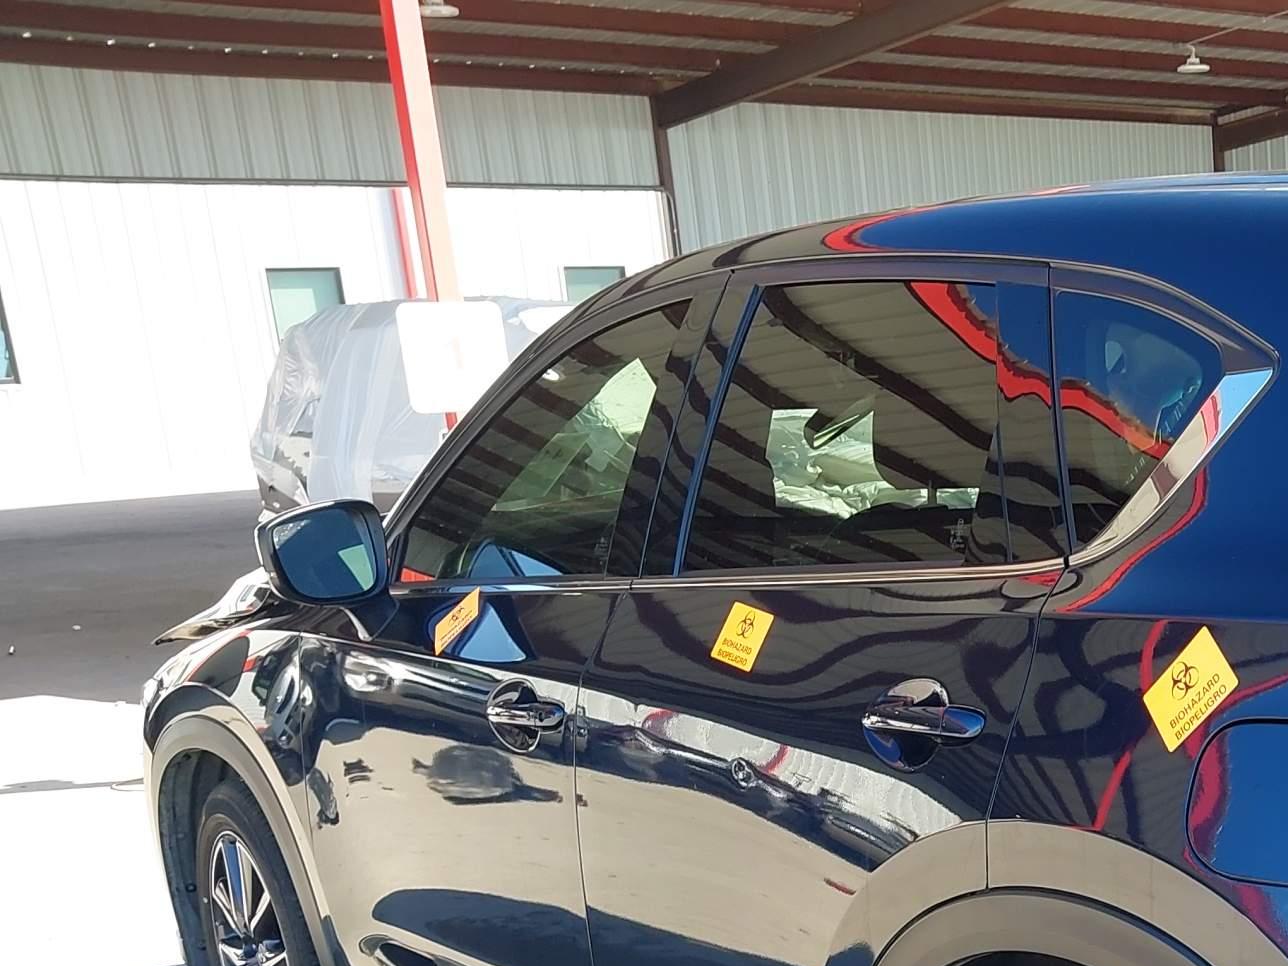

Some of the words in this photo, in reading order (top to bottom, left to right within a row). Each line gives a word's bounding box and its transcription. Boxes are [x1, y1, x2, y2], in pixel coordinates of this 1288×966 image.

[722, 637, 752, 656] BIOHAZARD
[1169, 672, 1221, 730] BIOHAZARD
[1174, 683, 1228, 741] BIOPELIGRO
